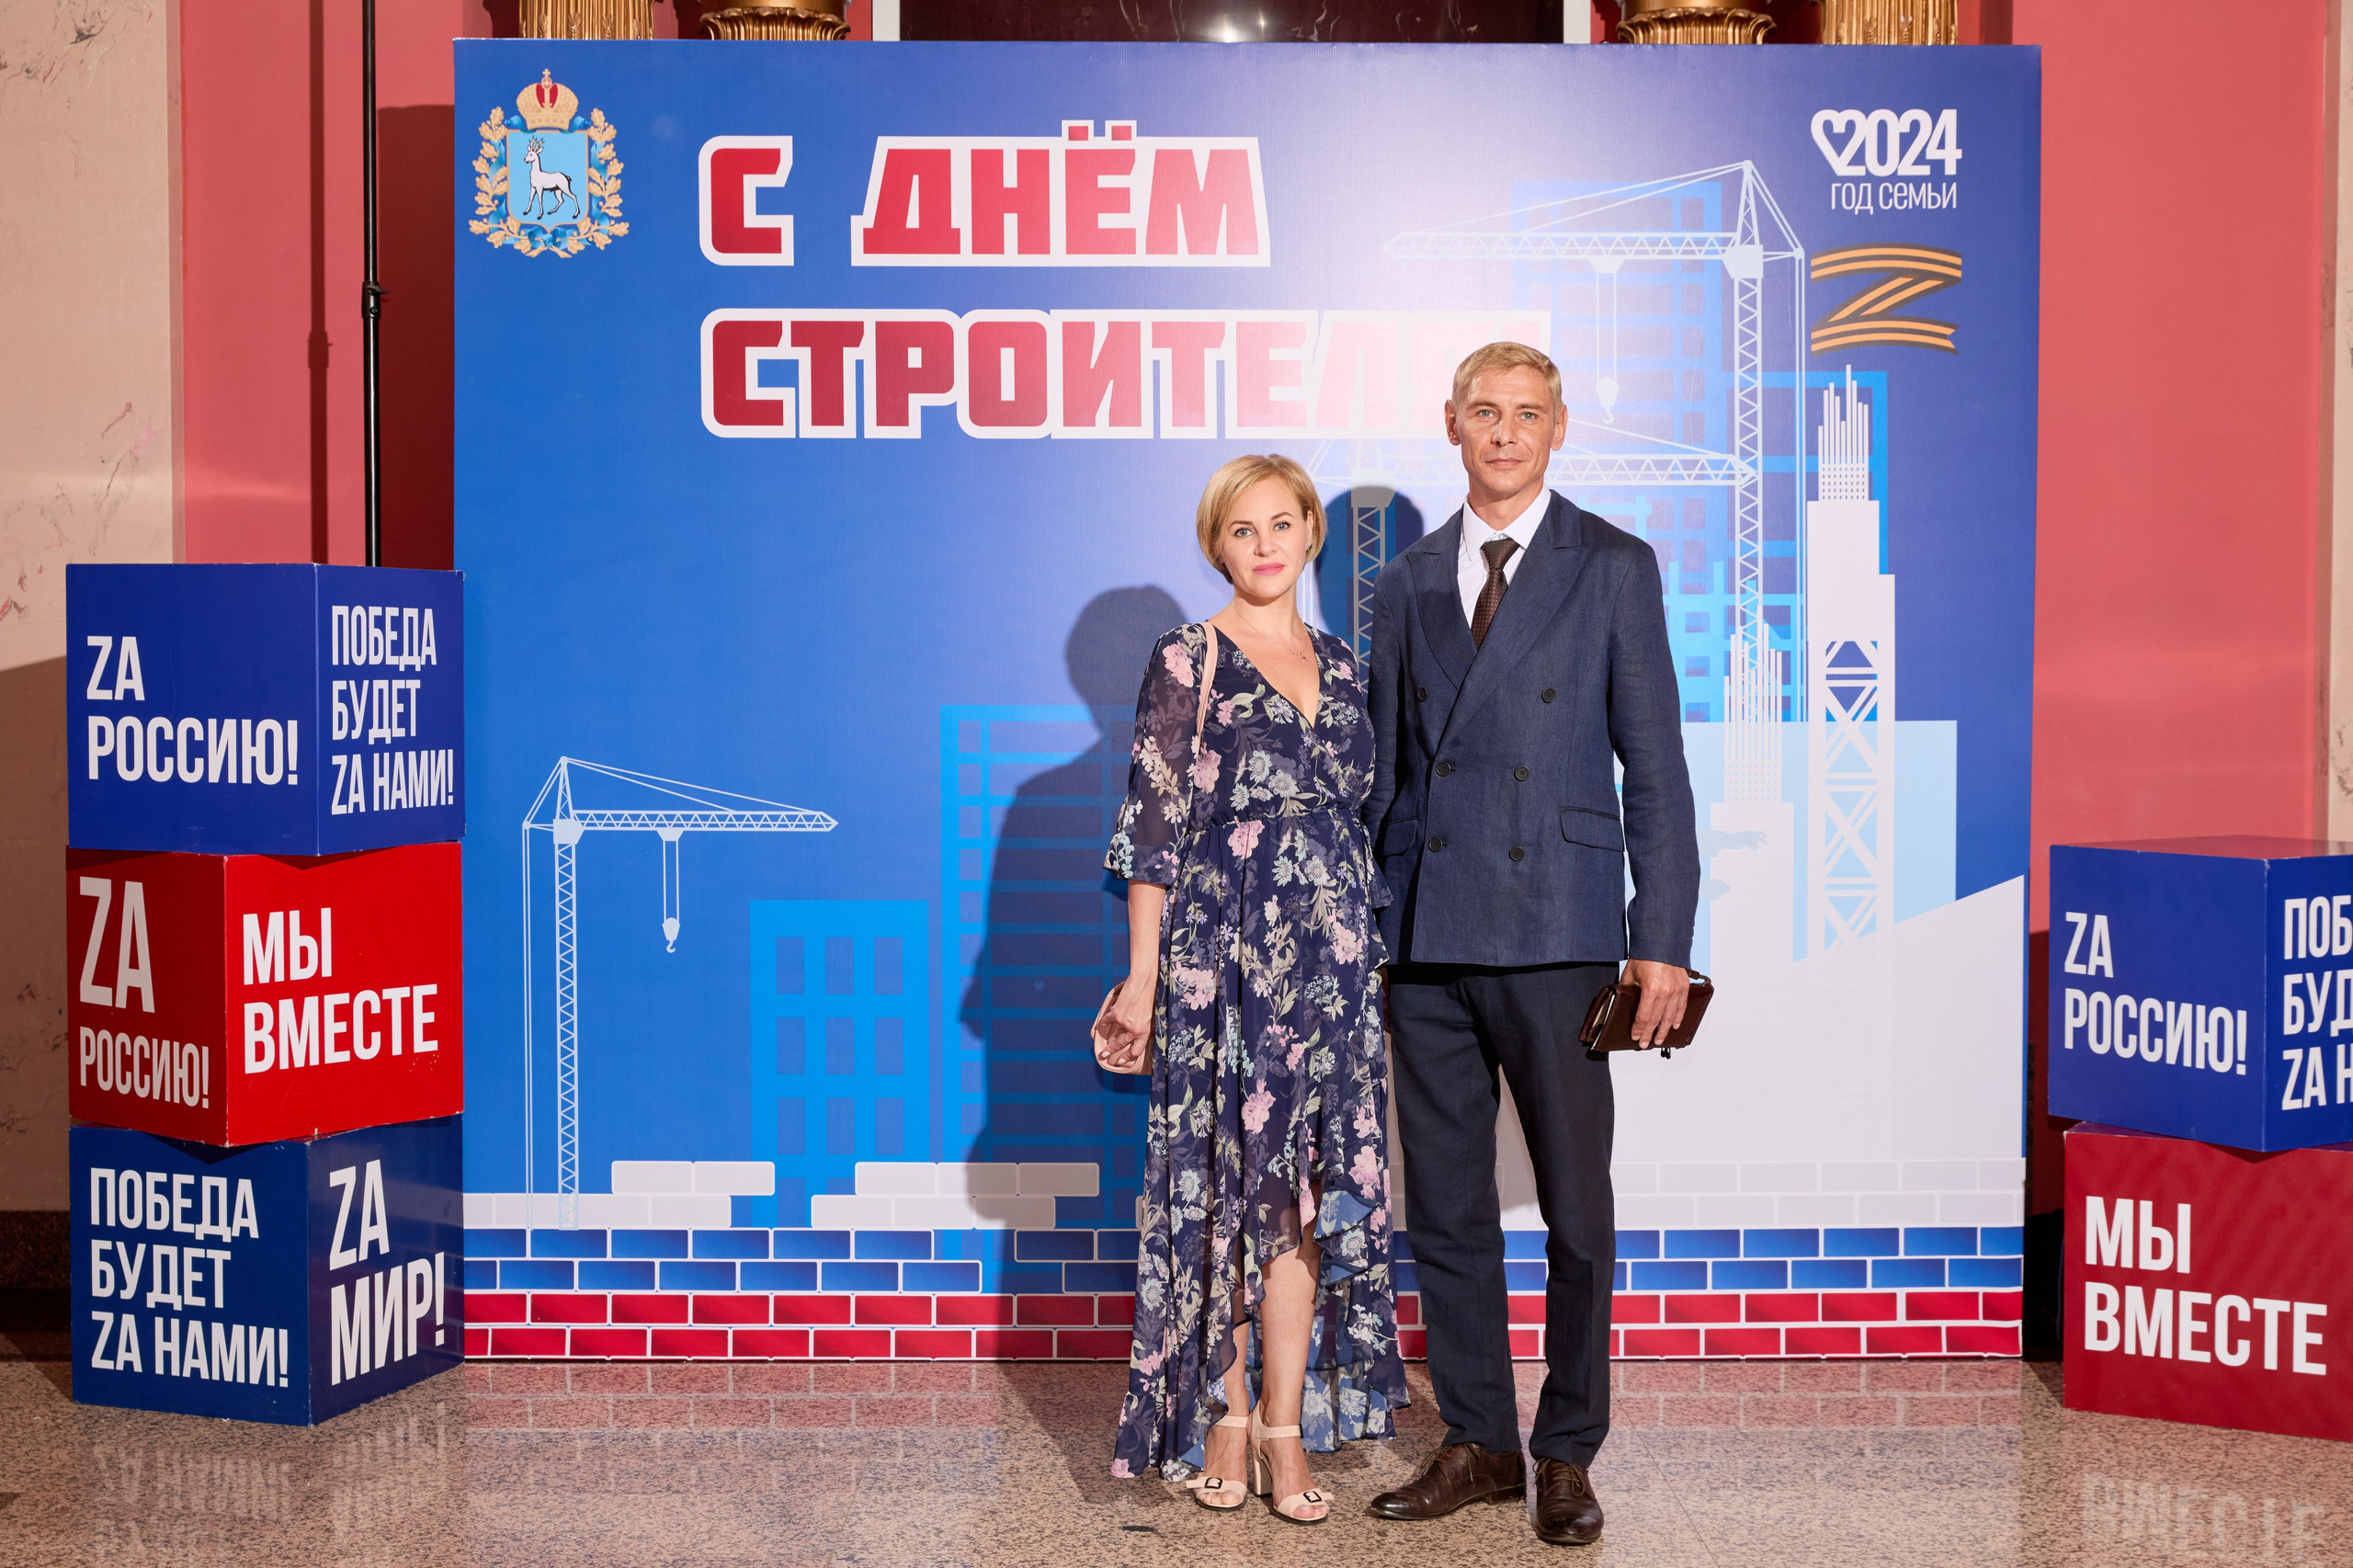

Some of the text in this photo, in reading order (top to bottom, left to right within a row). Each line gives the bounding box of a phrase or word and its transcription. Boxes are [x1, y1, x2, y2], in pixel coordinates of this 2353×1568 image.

[1811, 108, 1962, 176] 2024
[699, 119, 1271, 267] С ДНЁМ
[1811, 243, 1962, 357] Z
[700, 308, 1552, 439] СТРОИТЕЛЯ
[86, 635, 145, 701] ZA
[331, 605, 438, 672] ПОБЕДА
[87, 715, 299, 786] РОССИЮ!
[332, 679, 421, 744] БУДЕТ
[330, 749, 455, 815] ZA НАМИ!
[79, 875, 155, 1014] ZA
[243, 906, 333, 986] МЫ
[2063, 911, 2114, 979] ZA
[79, 1026, 210, 1110] РОССИЮ!
[244, 983, 439, 1074] ВМЕСТЕ
[2063, 987, 2248, 1076] РОССИЮ!
[2281, 1046, 2328, 1111] ZA
[89, 1167, 260, 1244] ПОБЕДА
[328, 1159, 390, 1271] ZA
[2085, 1195, 2192, 1275] МЫ
[90, 1239, 233, 1310] БУДЕТ
[90, 1310, 290, 1389] ZA НАМИ!
[330, 1252, 446, 1387] МИР!
[2083, 1280, 2328, 1376] ВМЕСТЕ
